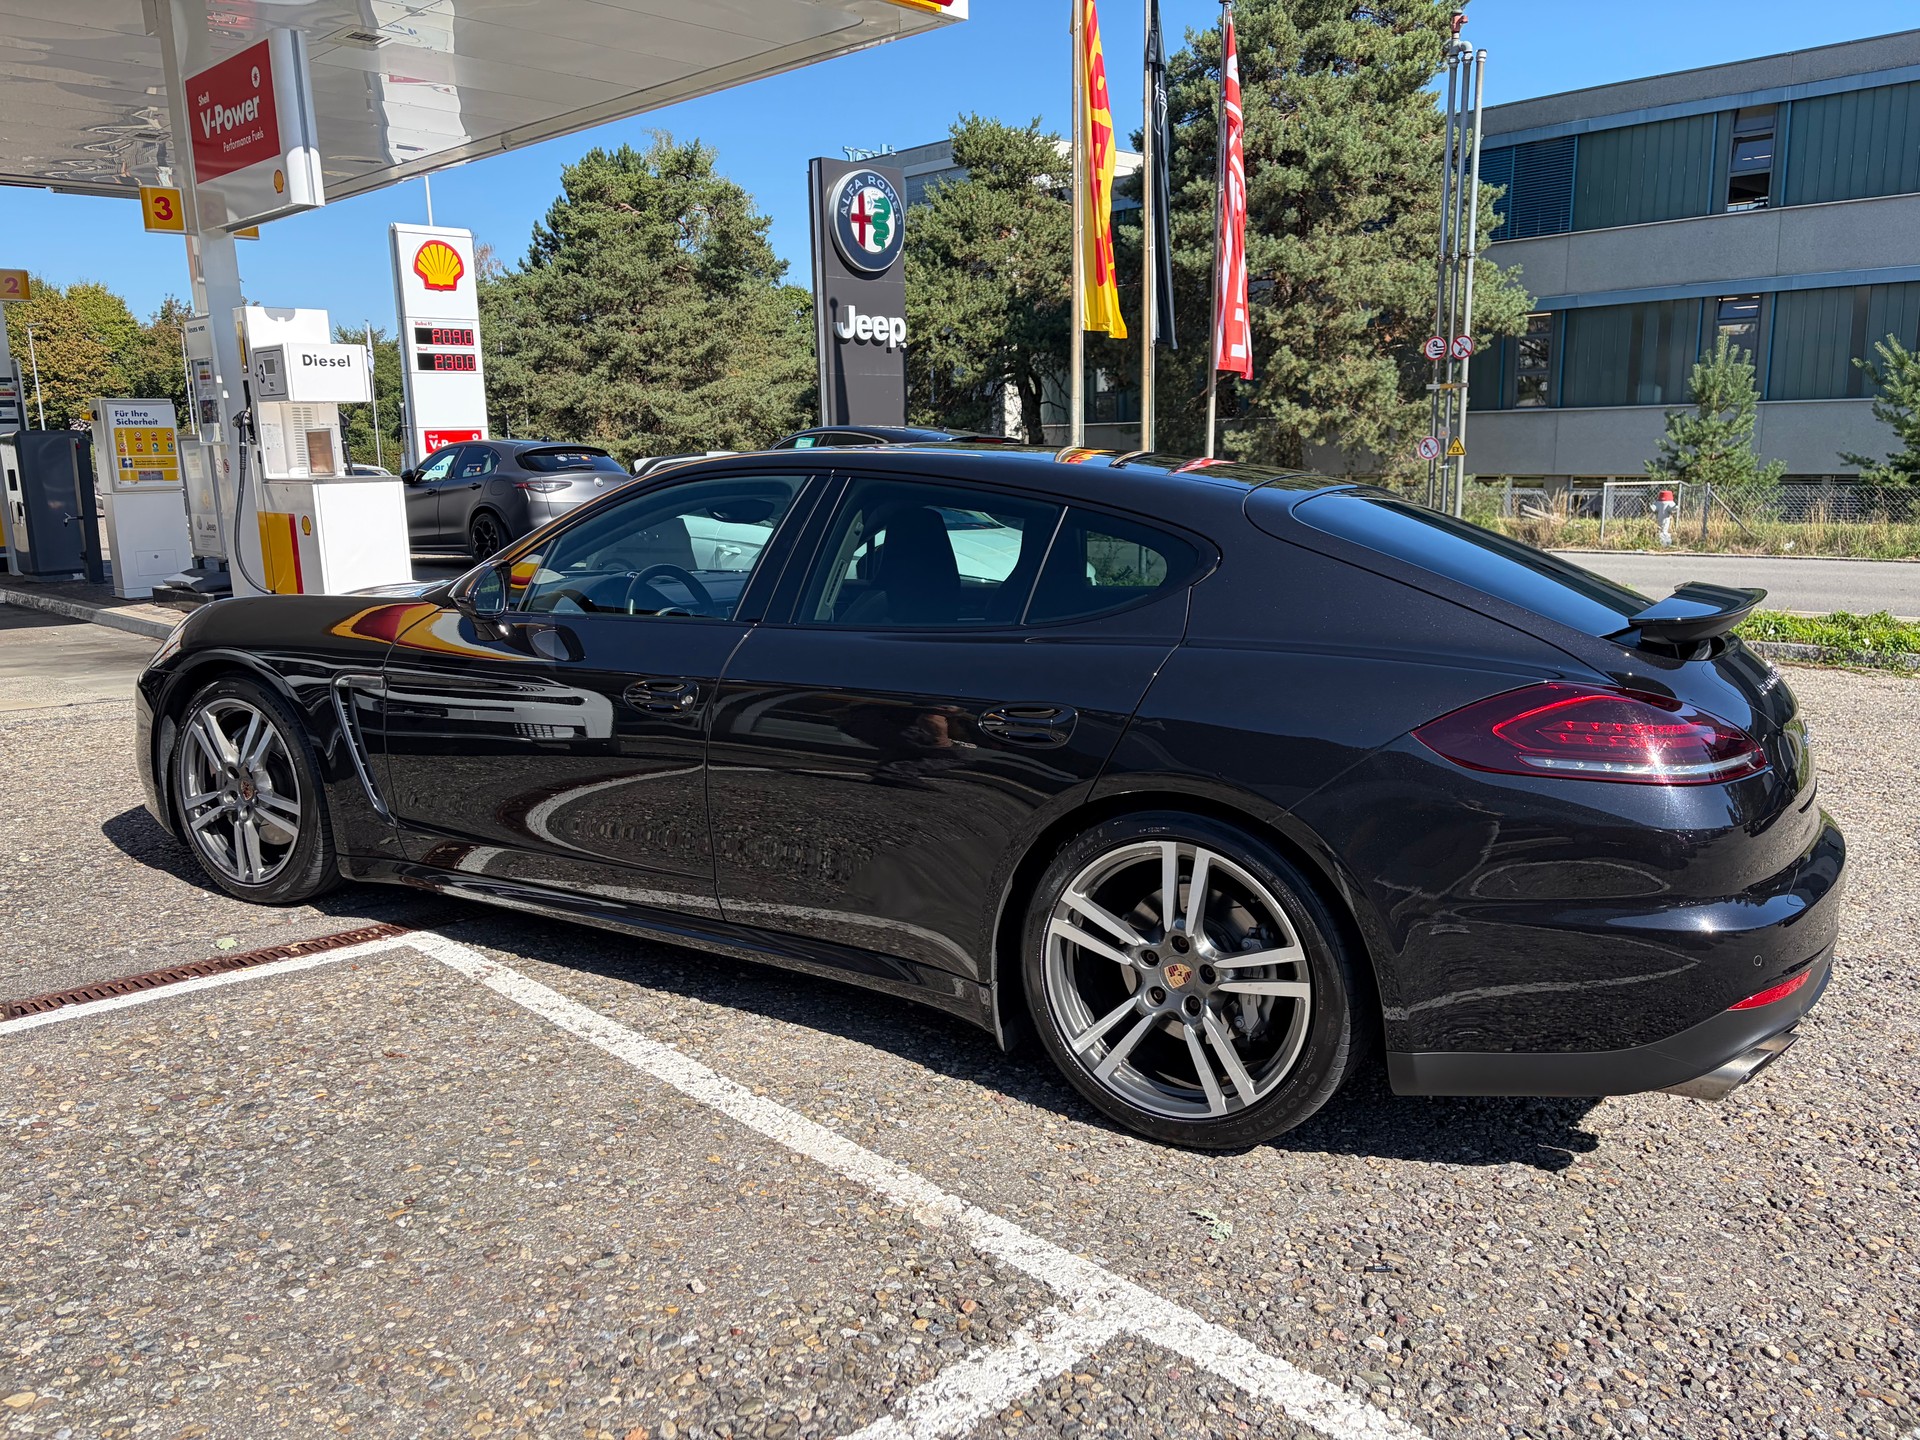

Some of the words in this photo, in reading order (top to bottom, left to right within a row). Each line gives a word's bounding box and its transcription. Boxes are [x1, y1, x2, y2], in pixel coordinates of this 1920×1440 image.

[198, 91, 210, 107] Shell
[200, 95, 260, 139] V-Power
[223, 136, 252, 153] Performance
[251, 126, 264, 142] Fuels
[154, 196, 174, 221] 3
[840, 179, 863, 218] ALFA
[867, 174, 902, 225] ROMEO
[4, 277, 20, 294] 2
[833, 305, 907, 348] Jeep
[432, 328, 474, 346] 209.0
[302, 354, 351, 367] Diesel
[434, 354, 476, 371] 230.0
[259, 364, 266, 384] 3
[114, 410, 129, 418] Für
[131, 410, 149, 418] Ihre
[116, 418, 159, 426] Sicherheit
